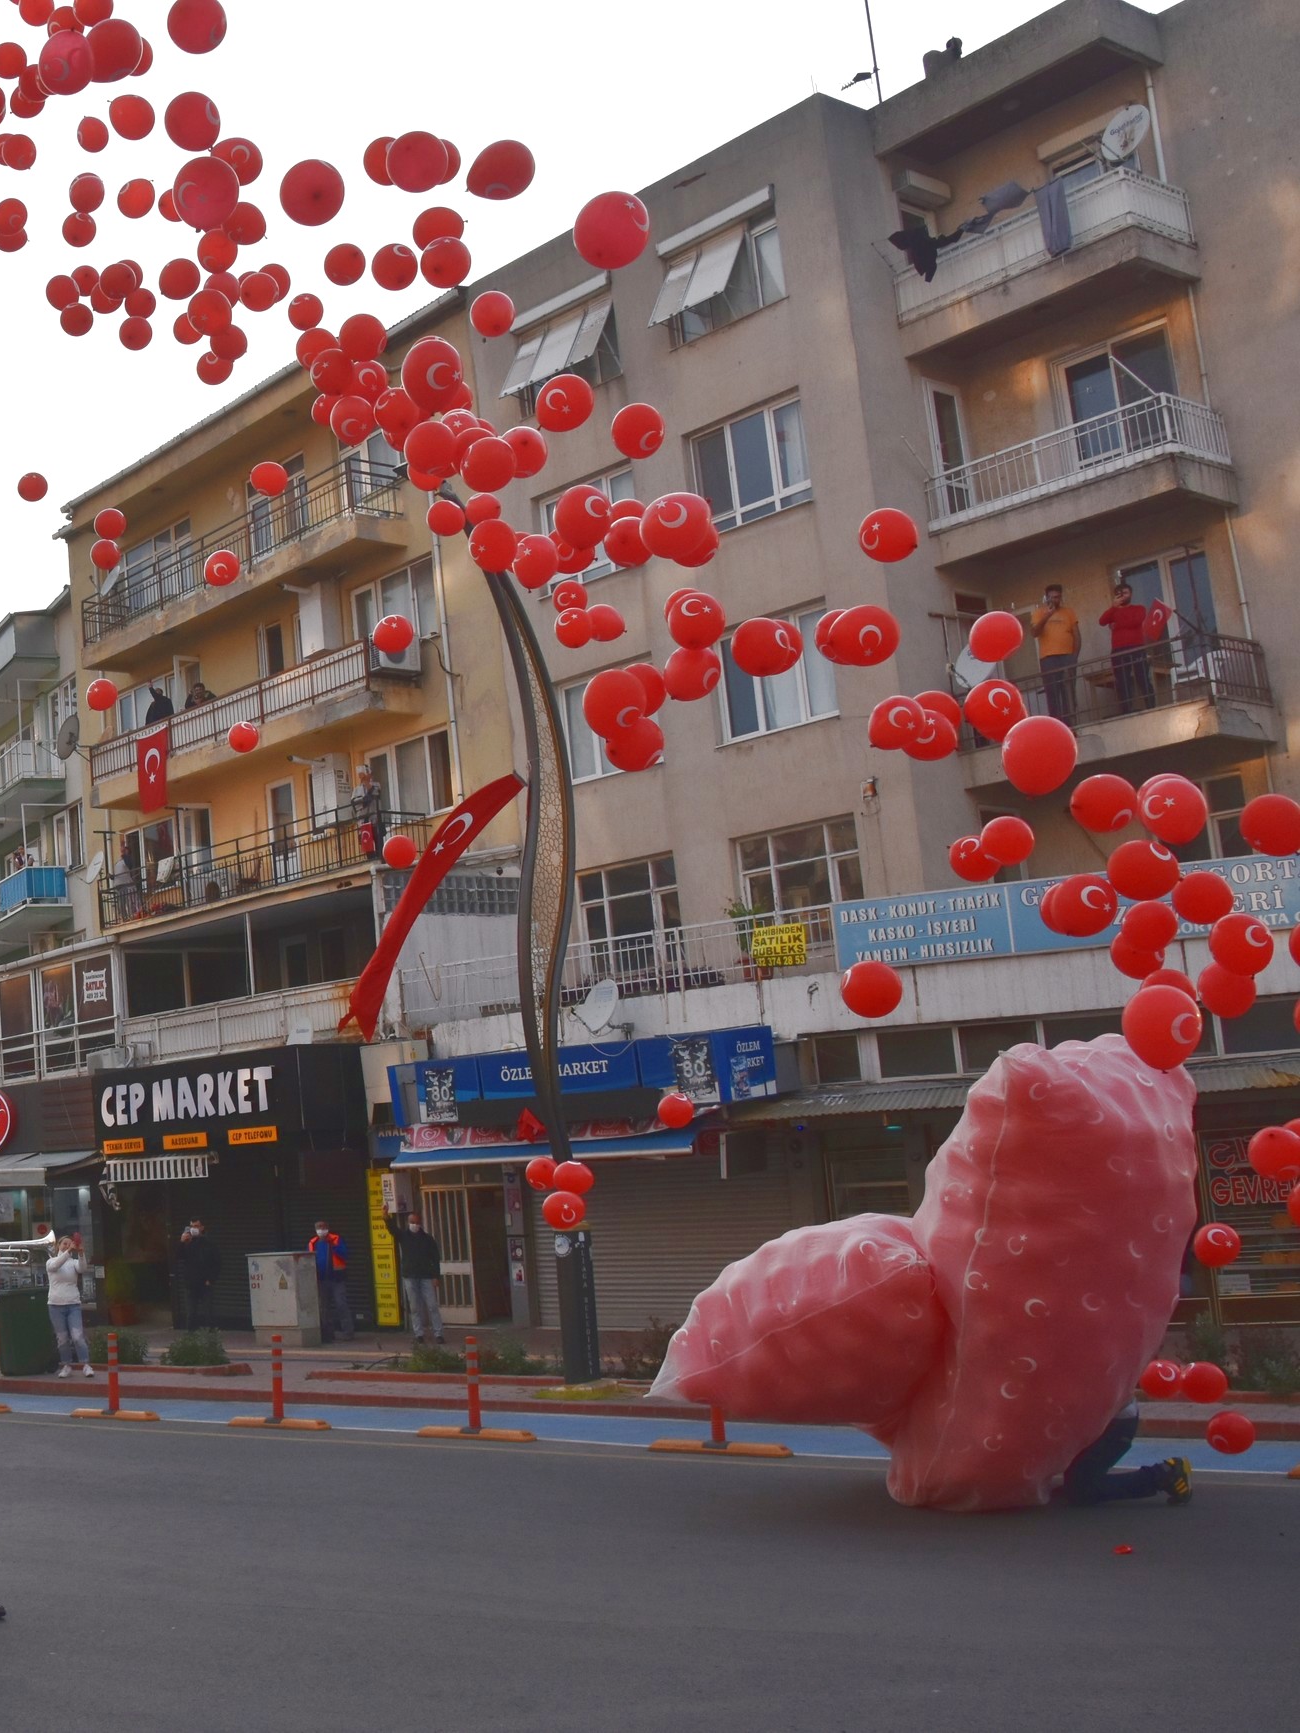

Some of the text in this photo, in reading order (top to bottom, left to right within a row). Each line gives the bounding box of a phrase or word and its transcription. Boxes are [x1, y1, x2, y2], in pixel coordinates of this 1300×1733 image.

[840, 907, 878, 923] DASK
[888, 900, 937, 918] KONUT
[948, 892, 1001, 911] TRAFİK
[868, 915, 976, 942] KASKO İŞYERİ
[753, 934, 803, 947] SATILIK
[856, 938, 994, 962] YANGIN HIRSIZLIK
[768, 956, 781, 966] 374
[783, 955, 793, 965] 28
[795, 954, 805, 965] 53
[736, 1041, 760, 1053] ÖZLEM
[683, 1060, 705, 1078] 80
[747, 1056, 765, 1068] RKET
[501, 1066, 533, 1082] ÖZLE
[101, 1066, 273, 1127] CEP MARKET
[431, 1085, 450, 1102] 80
[232, 1130, 273, 1141] CEP TELEFONU
[1209, 1174, 1297, 1206] GEVRE
